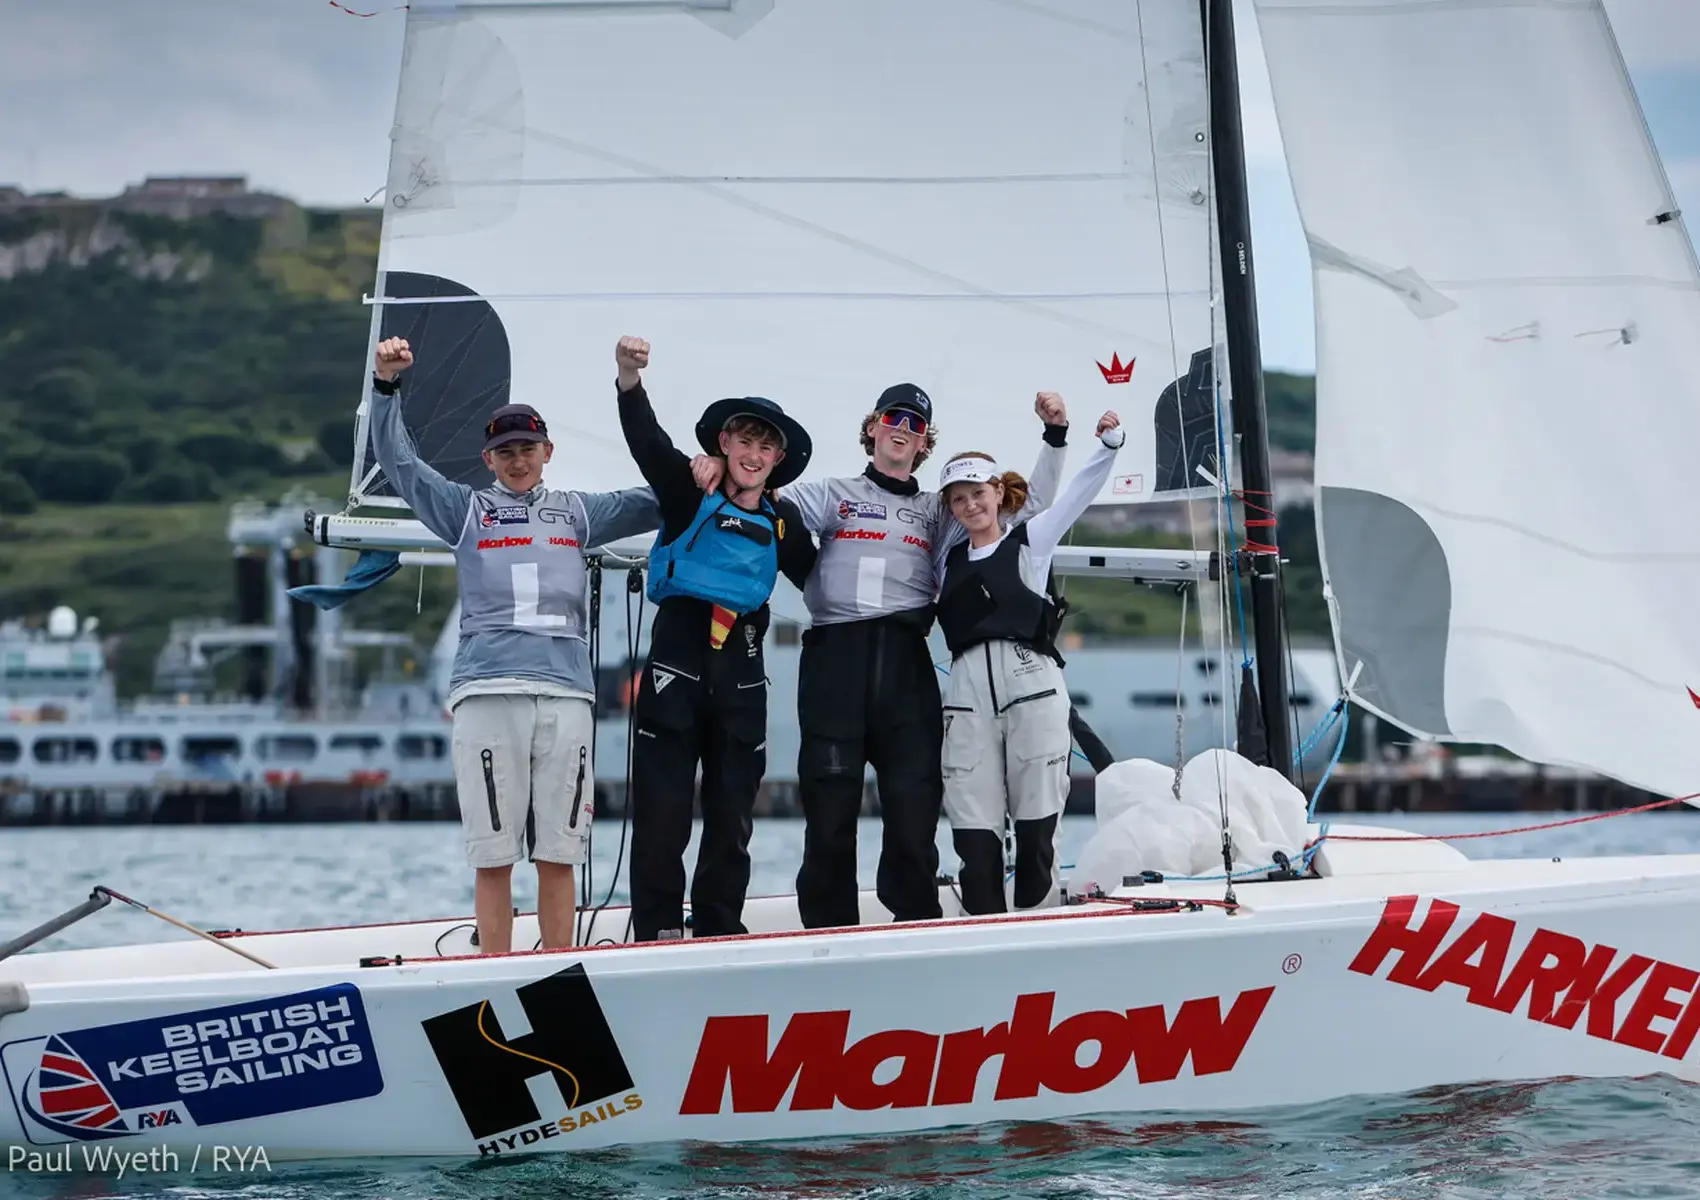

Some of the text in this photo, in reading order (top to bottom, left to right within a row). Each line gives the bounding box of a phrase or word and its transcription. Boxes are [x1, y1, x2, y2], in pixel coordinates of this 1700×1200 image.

[477, 536, 533, 550] Marlow
[511, 563, 567, 626] L
[162, 996, 352, 1048] BRITISH
[107, 1020, 356, 1082] KEELBOAT
[175, 1043, 363, 1094] SAILING
[678, 985, 1276, 1115] Marlow
[138, 1108, 182, 1130] RYA
